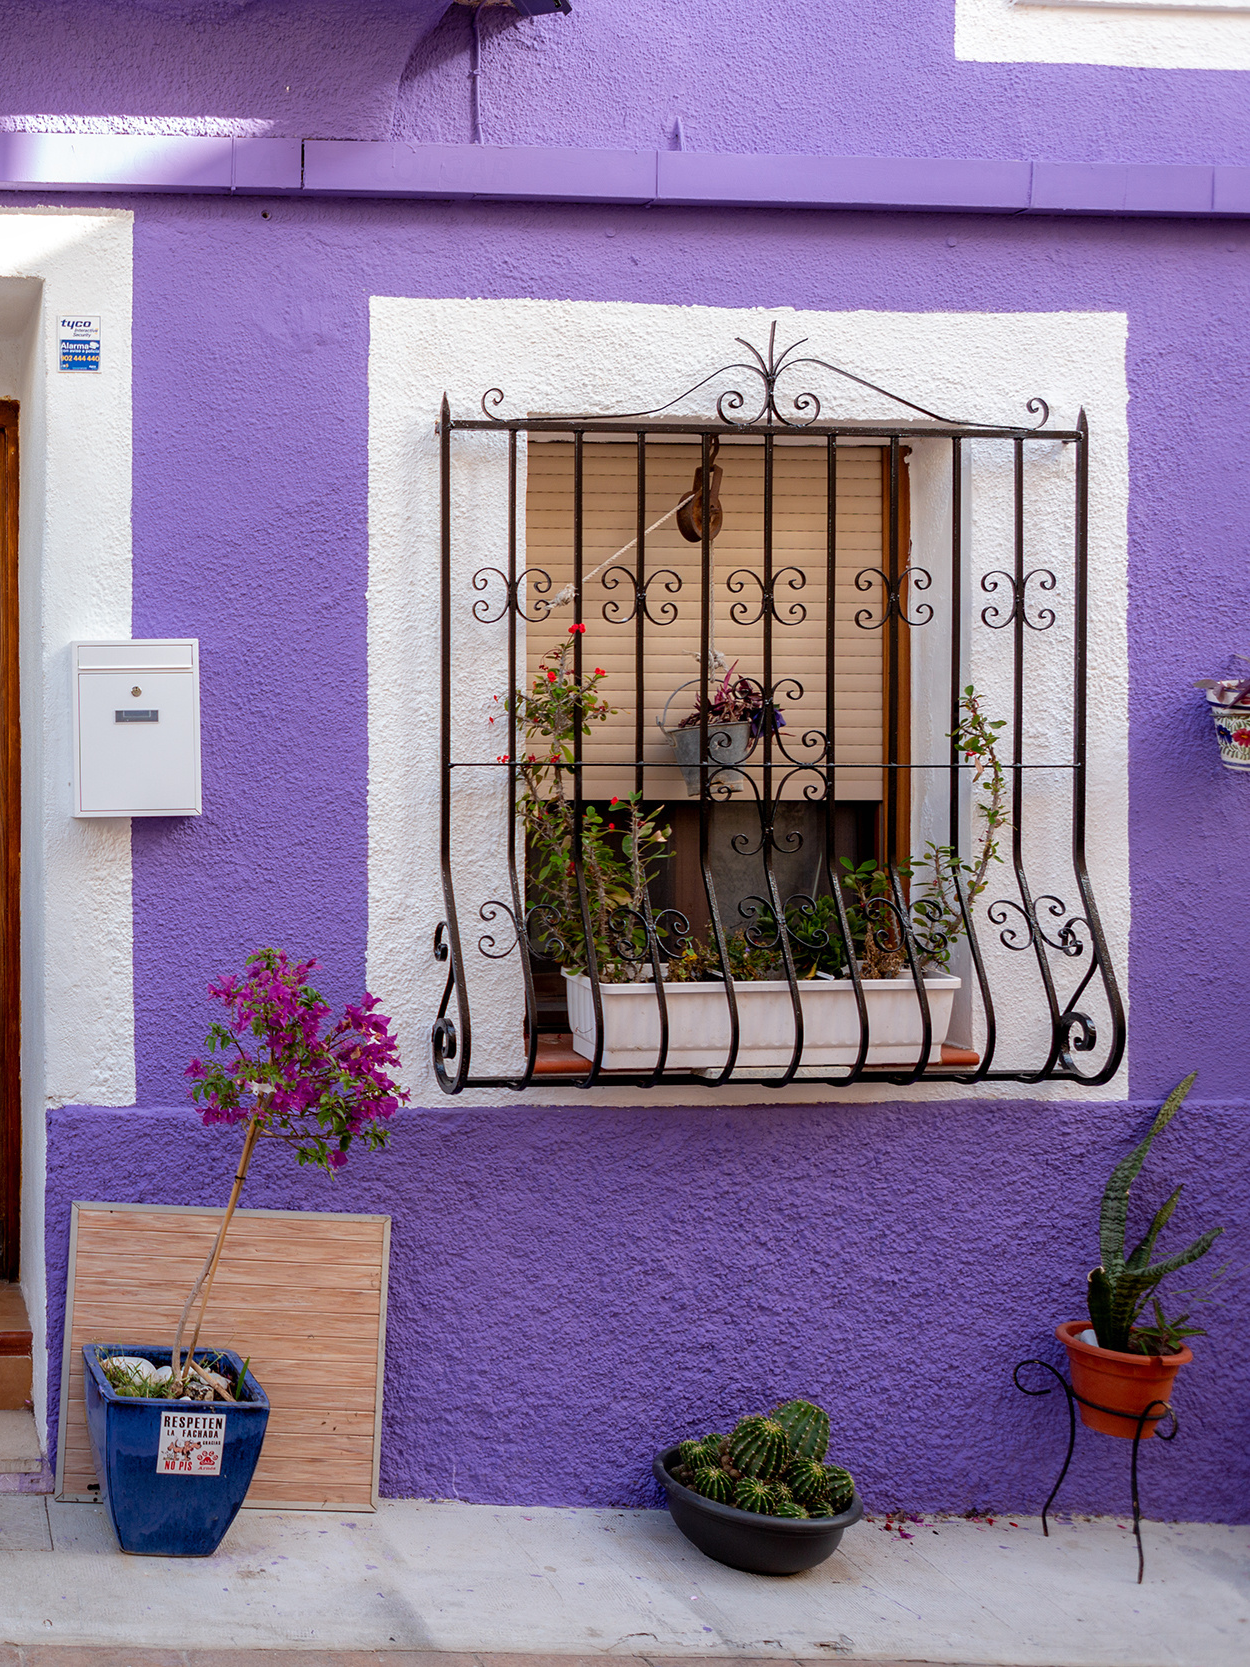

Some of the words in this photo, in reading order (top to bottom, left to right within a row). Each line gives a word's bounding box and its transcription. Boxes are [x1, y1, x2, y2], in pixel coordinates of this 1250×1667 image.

[61, 319, 91, 329] tyco
[61, 341, 89, 349] Alarma
[164, 1415, 223, 1429] RESPETEN
[182, 1429, 219, 1438] FACHADA
[164, 1460, 175, 1470] NO
[179, 1460, 192, 1471] PIS
